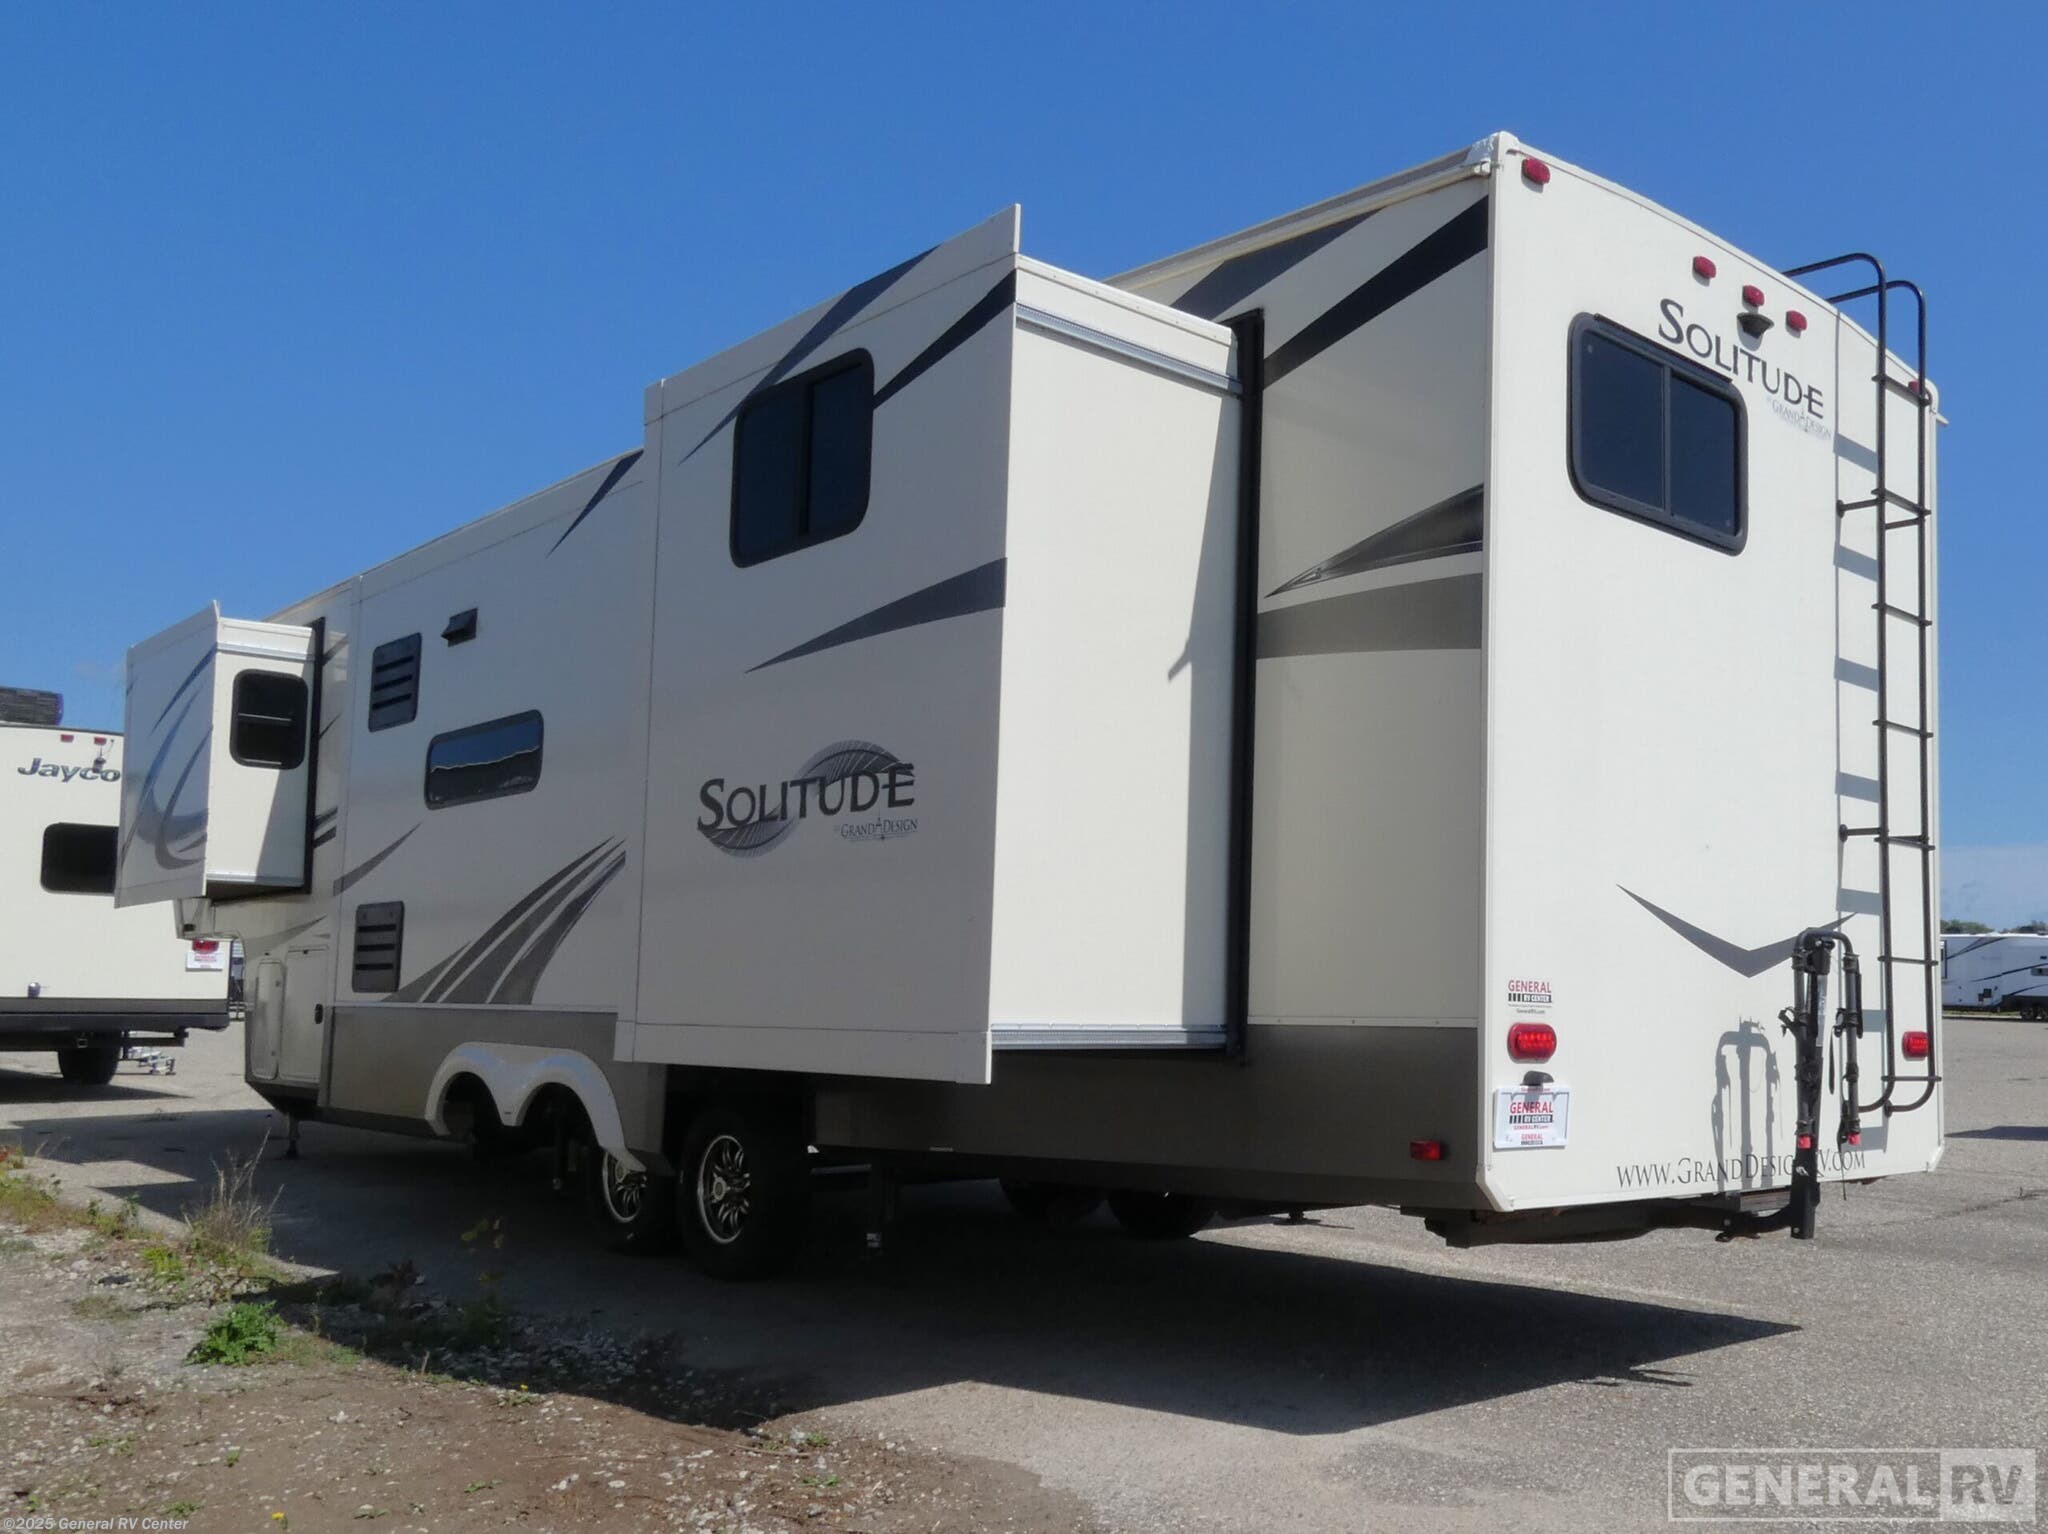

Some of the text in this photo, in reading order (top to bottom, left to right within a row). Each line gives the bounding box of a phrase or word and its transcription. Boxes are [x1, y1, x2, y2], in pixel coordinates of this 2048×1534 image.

[1659, 298, 1824, 420] SOLITUDE
[17, 758, 121, 782] Jayco
[697, 763, 915, 829] SOLITUDE
[1508, 980, 1552, 993] GENERAL
[1510, 1101, 1553, 1113] GENERAL
